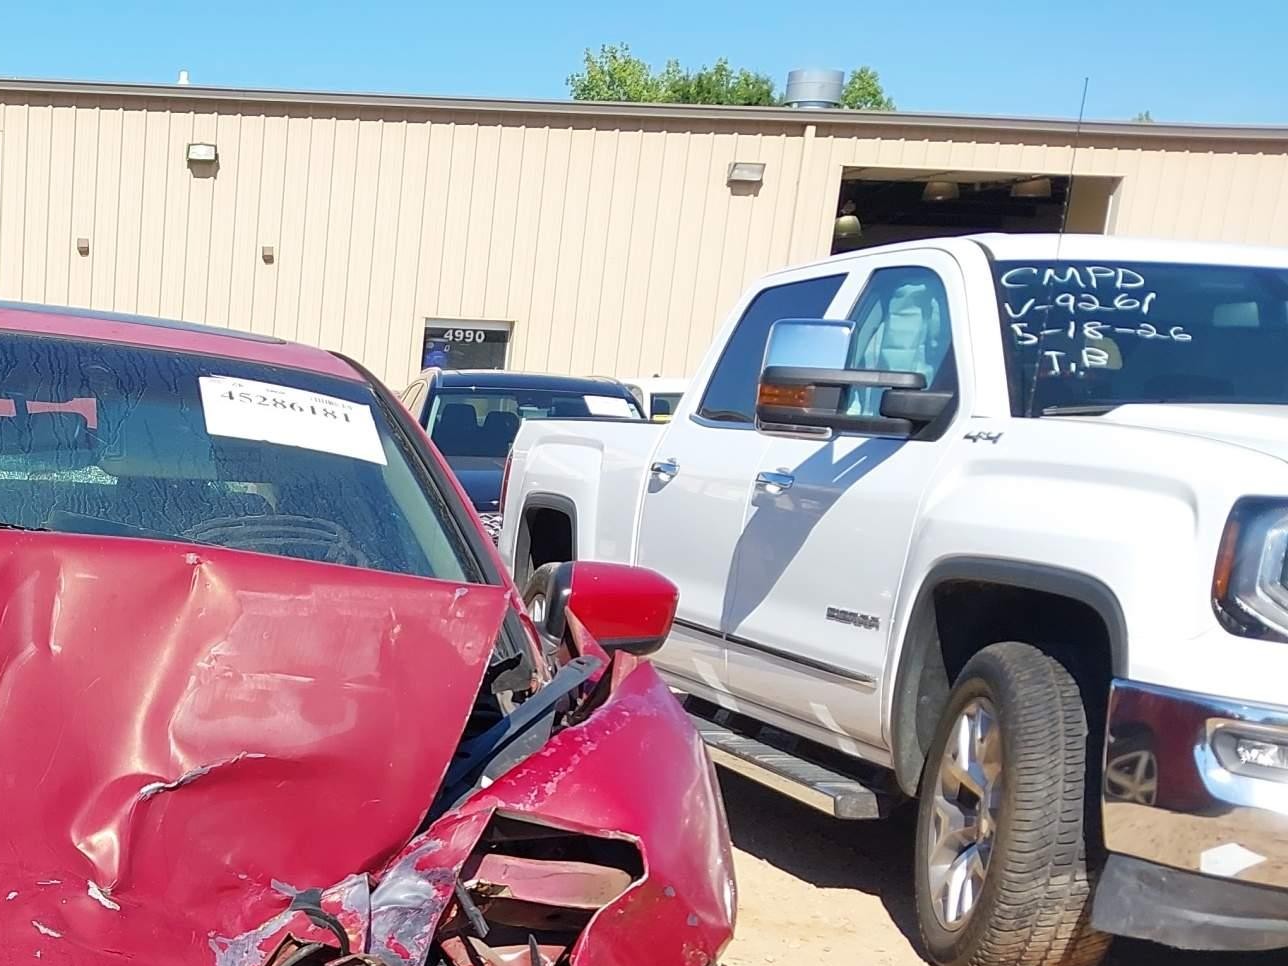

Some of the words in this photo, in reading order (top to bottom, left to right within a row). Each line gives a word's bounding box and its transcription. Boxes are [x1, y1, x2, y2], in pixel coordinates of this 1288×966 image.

[1000, 266, 1145, 289] CMPD
[1003, 291, 1157, 318] V-9261
[443, 329, 486, 343] 4990
[1010, 320, 1193, 346] 5-18-26
[220, 389, 352, 424] 45286181
